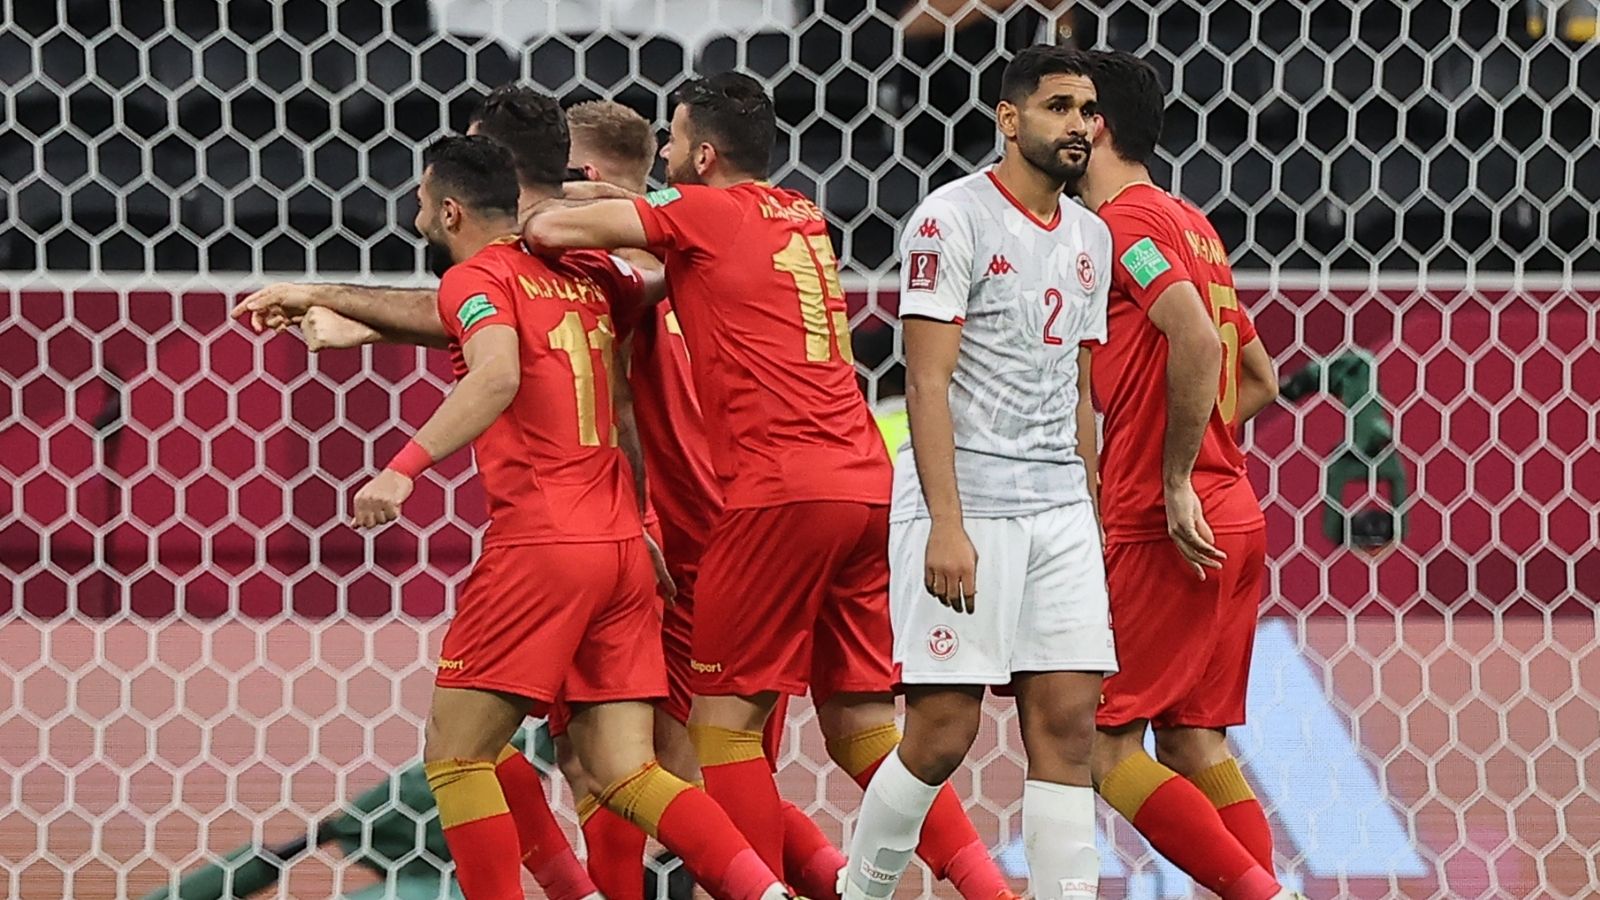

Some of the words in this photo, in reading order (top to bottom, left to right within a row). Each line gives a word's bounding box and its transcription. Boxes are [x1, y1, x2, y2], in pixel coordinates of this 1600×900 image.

[547, 310, 619, 448] 11
[1043, 287, 1063, 345] 2
[1207, 280, 1239, 424] 5
